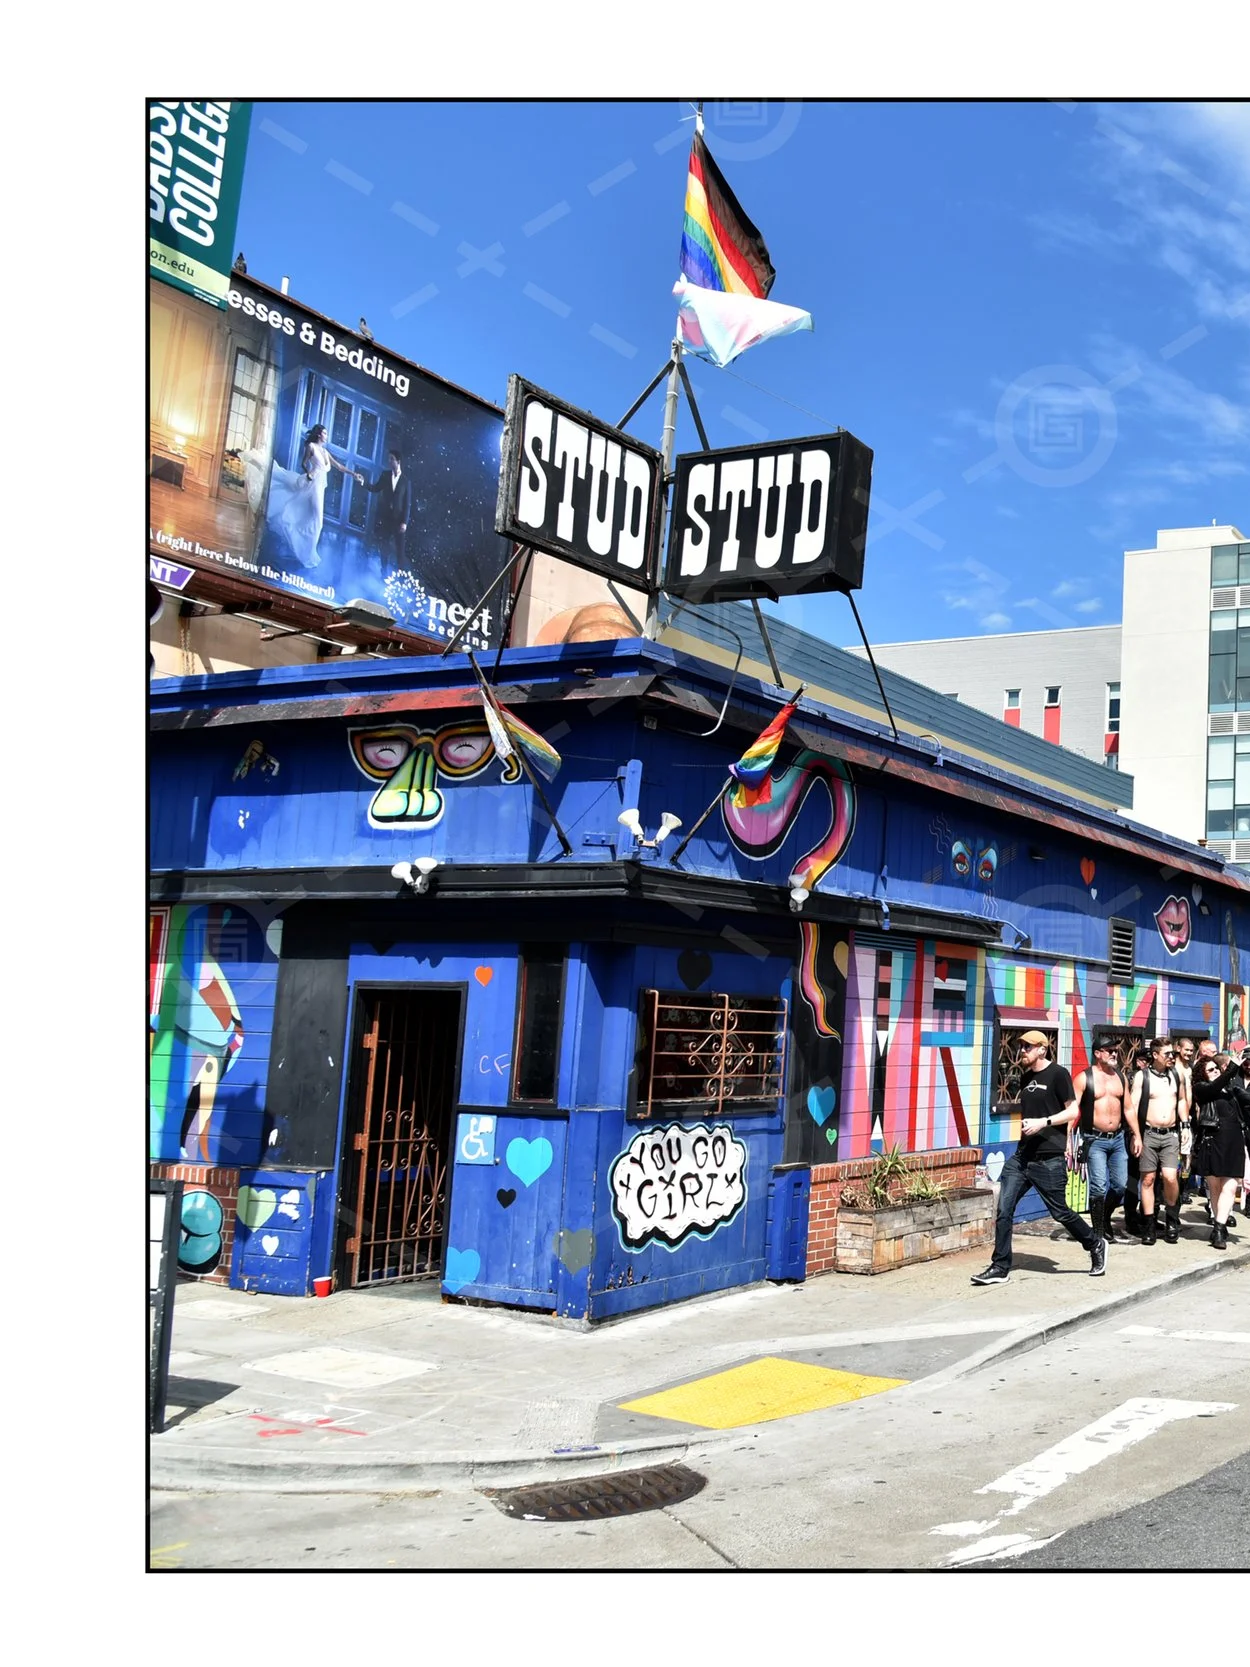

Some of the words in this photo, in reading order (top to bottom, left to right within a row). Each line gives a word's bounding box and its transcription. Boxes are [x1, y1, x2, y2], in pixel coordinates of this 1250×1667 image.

[168, 102, 231, 247] COLLEG
[299, 325, 317, 346] &
[320, 332, 410, 397] Bedding
[518, 400, 653, 571] STUD
[680, 449, 832, 577] STUD
[195, 542, 224, 562] here
[225, 552, 260, 574] below
[261, 566, 280, 580] the
[281, 571, 336, 600] billboard)
[428, 619, 489, 650] beding
[630, 1137, 682, 1175] YOU
[692, 1135, 726, 1169] GO
[637, 1170, 724, 1219] GIRL
